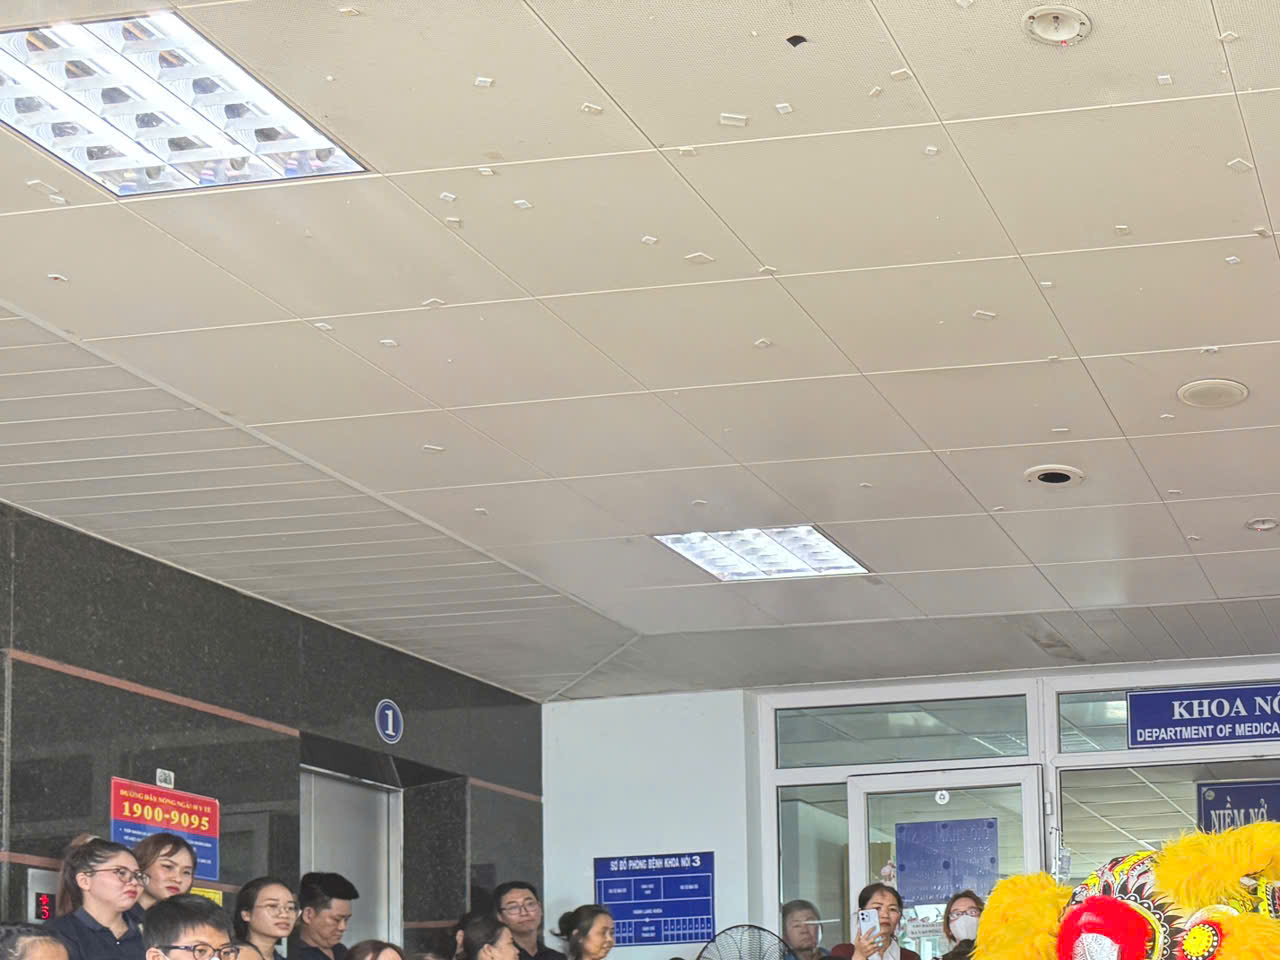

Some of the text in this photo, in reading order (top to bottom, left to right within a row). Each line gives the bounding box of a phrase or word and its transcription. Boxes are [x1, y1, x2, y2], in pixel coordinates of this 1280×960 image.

[1171, 698, 1248, 720] KHOA
[385, 710, 395, 735] 1
[1136, 725, 1214, 742] DEPARTMENT
[1216, 724, 1232, 737] OF
[122, 801, 210, 831] 1900-9095
[1210, 795, 1245, 834] NIỀM
[1249, 798, 1268, 824] NỞ
[692, 855, 701, 867] 3
